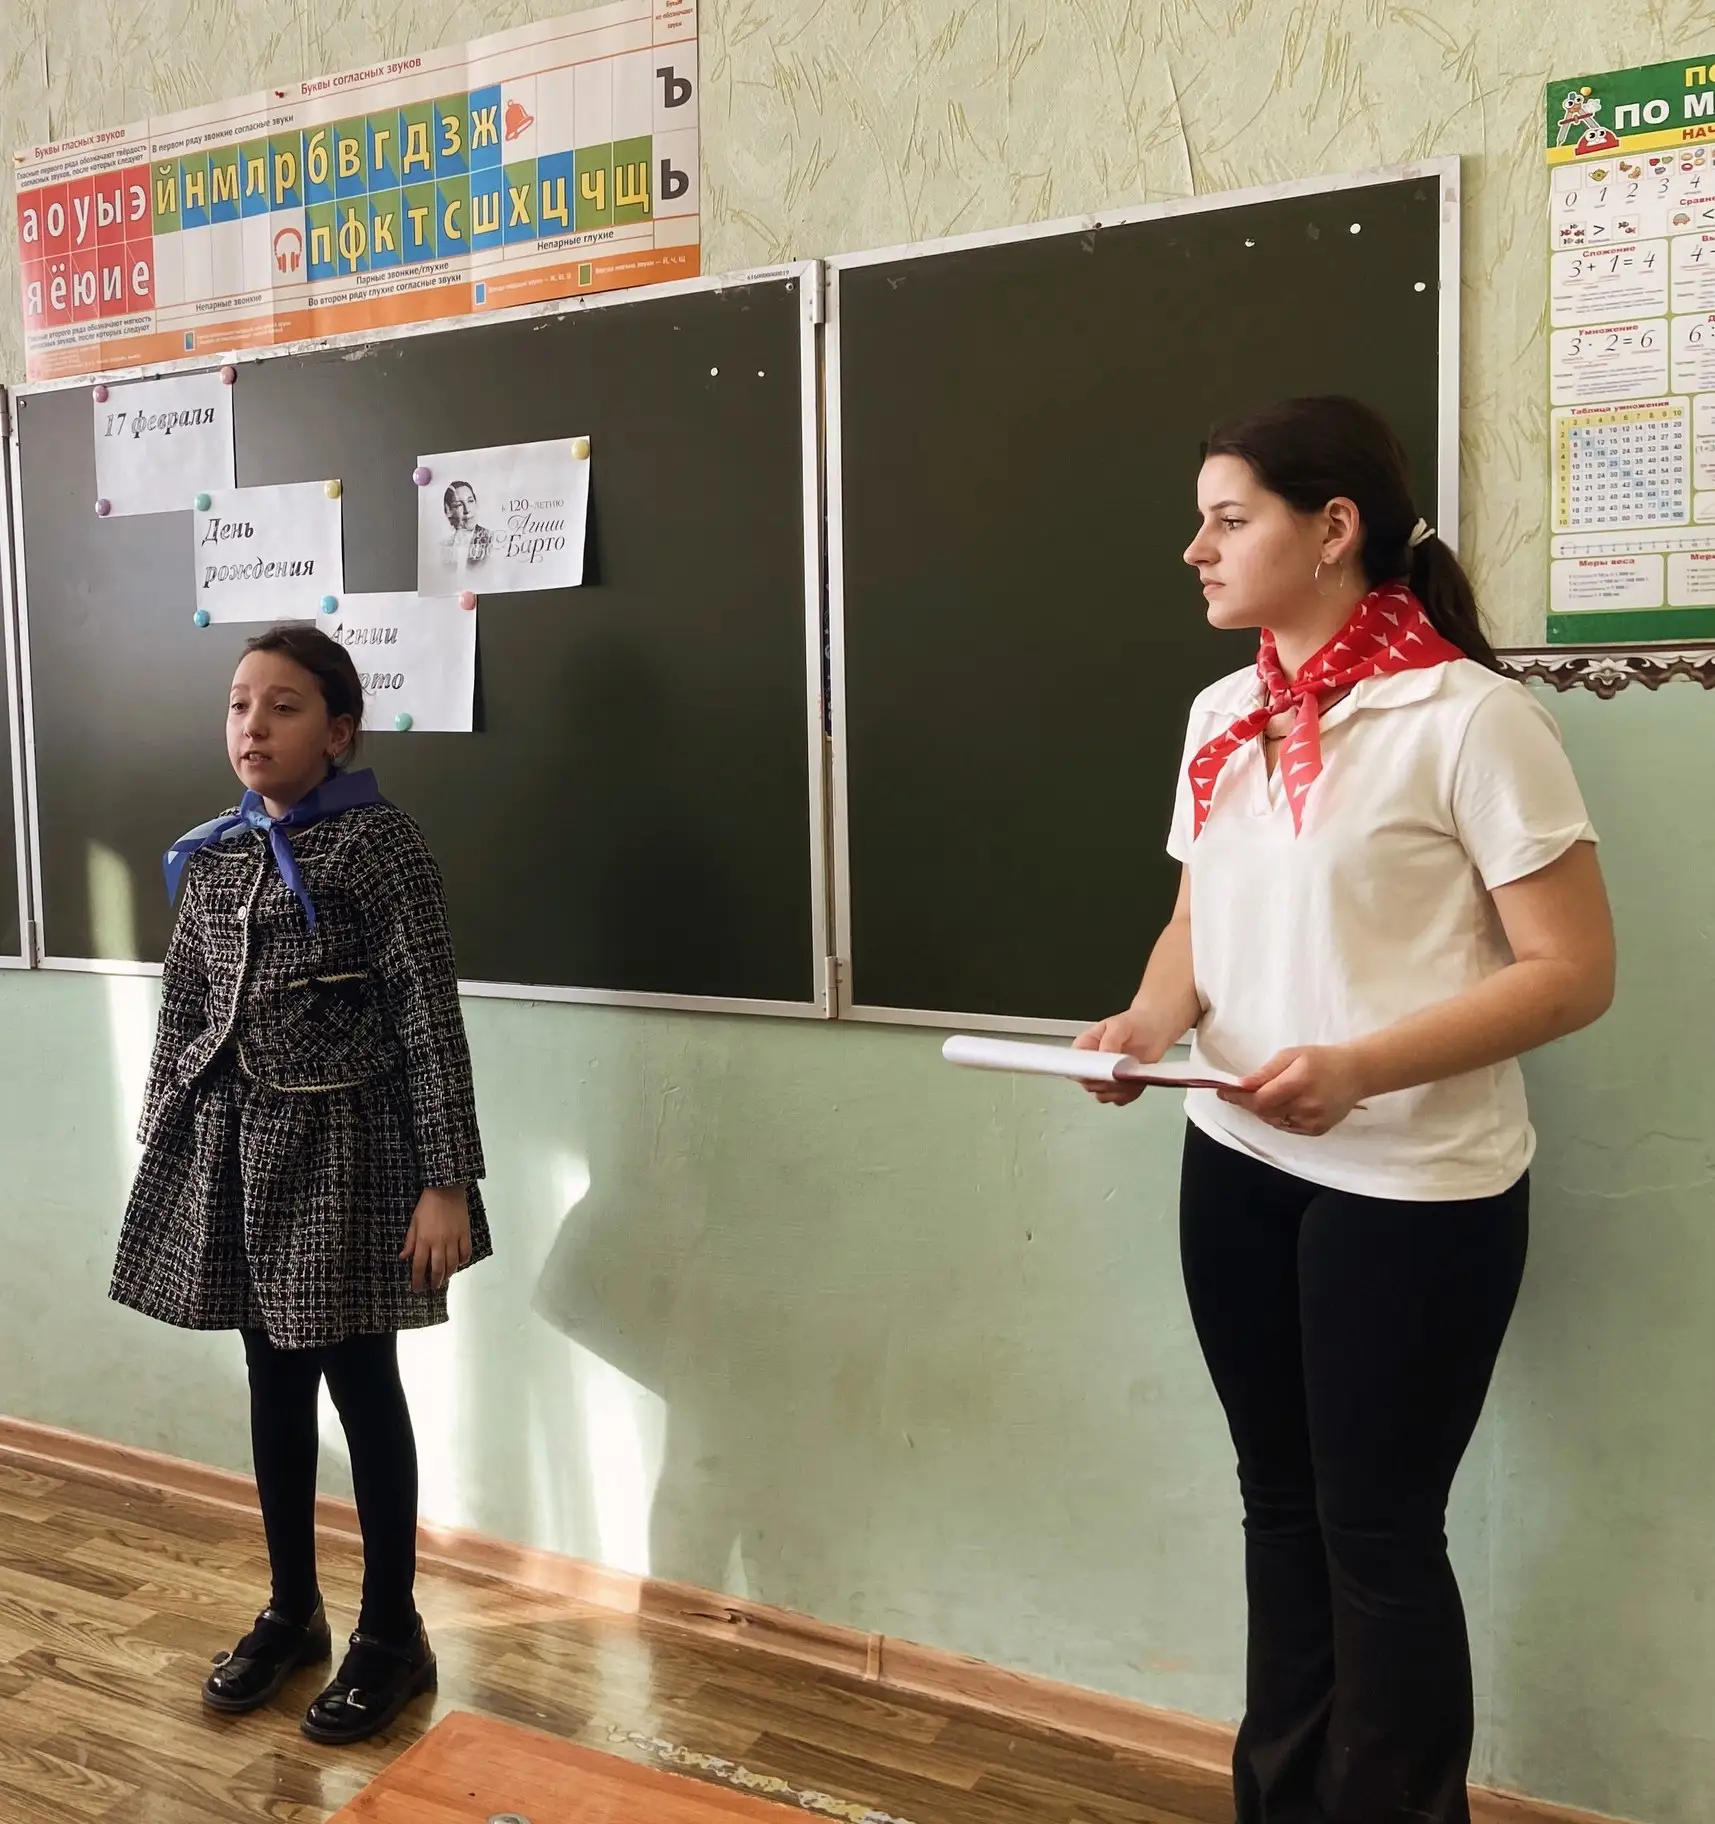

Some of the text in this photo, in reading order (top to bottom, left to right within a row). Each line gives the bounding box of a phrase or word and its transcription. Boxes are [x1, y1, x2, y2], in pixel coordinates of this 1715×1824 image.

[301, 57, 422, 96] Буквы согласных звуков
[1615, 99, 1670, 130] ПО
[34, 128, 126, 160] Буквы гласных звуков
[152, 114, 294, 154] В первом ряду звонкие согласные звуки
[20, 154, 144, 188] согласных звуков, после которых следуют
[40, 164, 64, 176] первого
[64, 160, 78, 172] ряда
[80, 152, 116, 166] обозначают
[1565, 174, 1700, 207] 0 1 2 3 4
[538, 229, 614, 251] Непарные глухие
[1582, 246, 1636, 258] Сложение
[1690, 244, 1703, 262] 4
[356, 260, 450, 286] Парные звонкие/глухие
[1569, 260, 1582, 278] 3
[1610, 254, 1619, 273] 1
[1643, 250, 1656, 268] 4
[27, 280, 42, 316] я
[196, 294, 262, 313] Непарные звонкие
[308, 274, 462, 308] Во втором ряду глухие согласные звуки
[48, 328, 72, 340] второго
[72, 326, 86, 337] ряда
[88, 320, 122, 332] обозначают
[124, 316, 152, 326] мягкость
[78, 333, 94, 342] после
[96, 328, 122, 340] которых
[124, 324, 150, 336] следуют
[1578, 324, 1639, 336] Умножение
[1689, 324, 1704, 343] 6
[1568, 338, 1582, 356] 3
[1604, 334, 1618, 352] 2
[1640, 330, 1656, 348] 6
[1570, 400, 1670, 416] Таблица умножения
[104, 407, 214, 439] 17 февраля
[201, 518, 254, 547] День
[508, 513, 564, 535] Агнии
[505, 534, 566, 564] Барто
[203, 556, 314, 589] рождения
[331, 622, 398, 646] Агнии
[359, 672, 404, 690] рто
